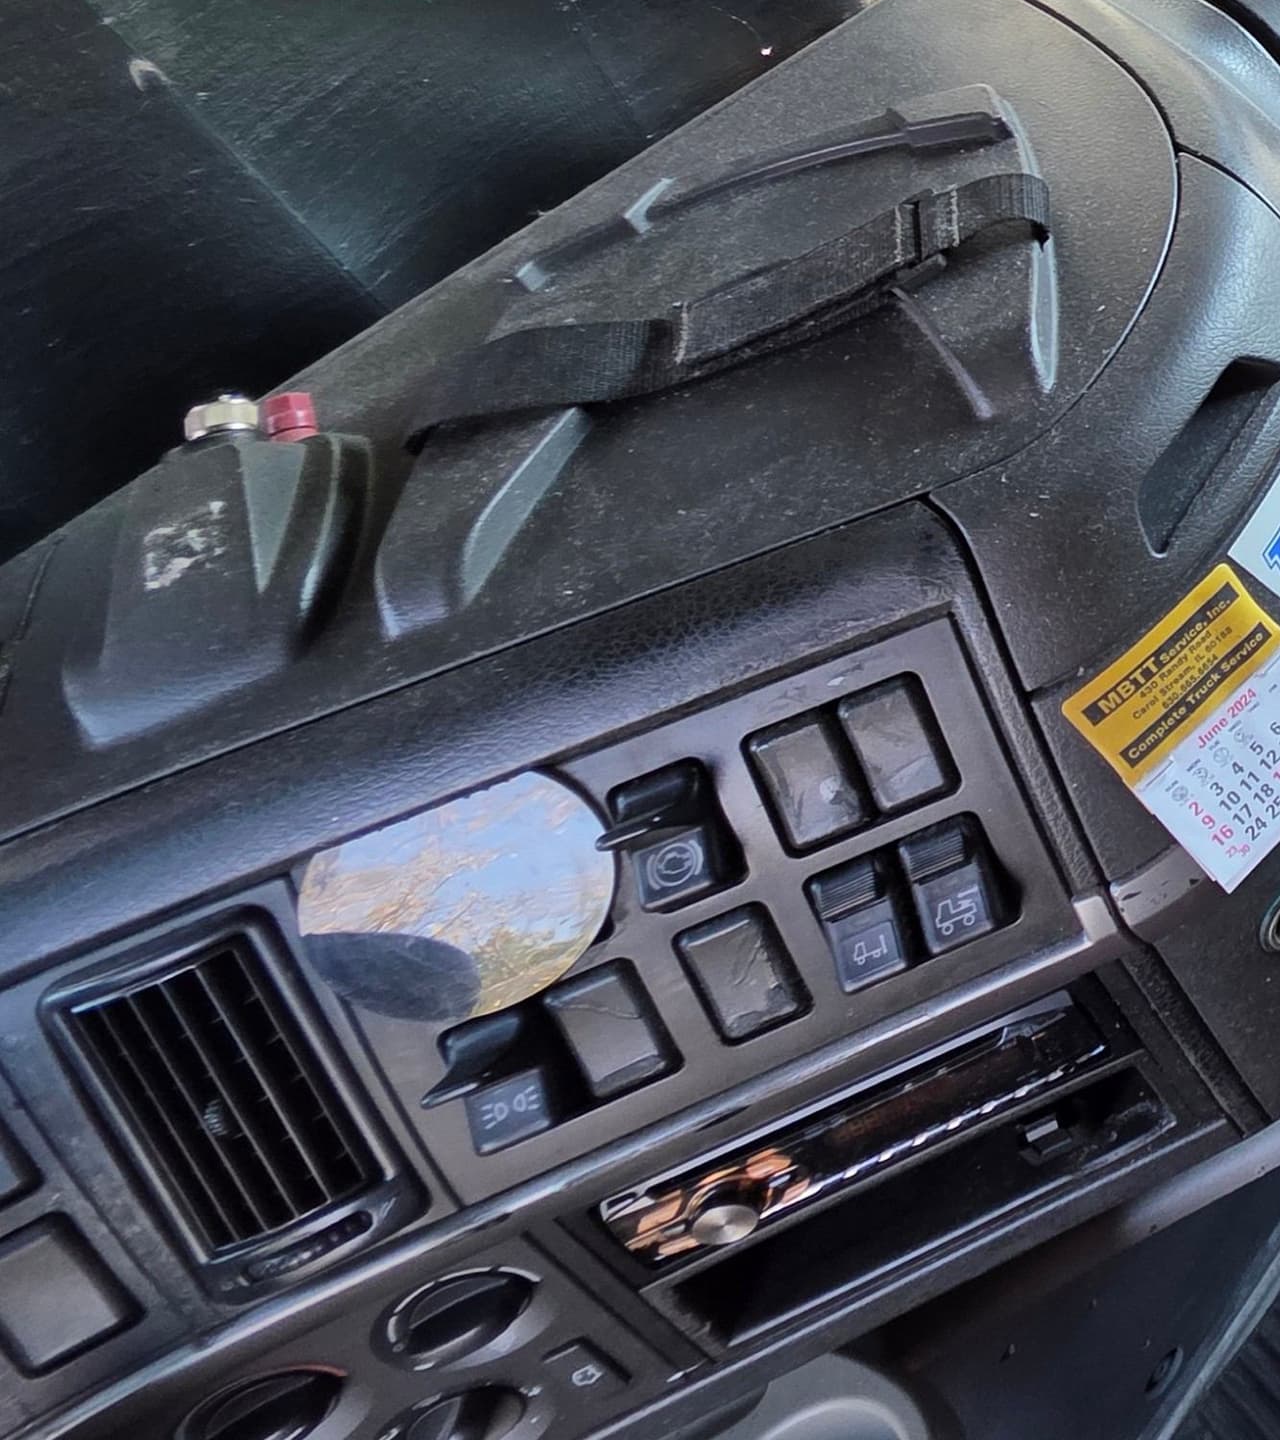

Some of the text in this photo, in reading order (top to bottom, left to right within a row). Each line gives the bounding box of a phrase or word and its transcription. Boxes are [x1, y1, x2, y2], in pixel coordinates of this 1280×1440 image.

[1098, 656, 1159, 714] MBTT
[1206, 598, 1231, 619] Inc.
[1140, 630, 1213, 700] 430 Randy Road
[1128, 633, 1263, 760] Complete Truck Service
[1132, 693, 1159, 720] Carol
[1198, 688, 1257, 749] June 2024
[1188, 802, 1204, 816] 2
[1210, 782, 1224, 797] 3
[1232, 761, 1244, 775] 4
[1250, 741, 1264, 756] 5
[1202, 815, 1216, 830] 9
[1220, 791, 1241, 811] 10
[1240, 771, 1260, 791] 11
[1260, 749, 1280, 771] 12
[1212, 824, 1234, 846] 16
[1232, 803, 1252, 825] 17
[1253, 783, 1274, 804] 18
[1245, 816, 1268, 841] 24
